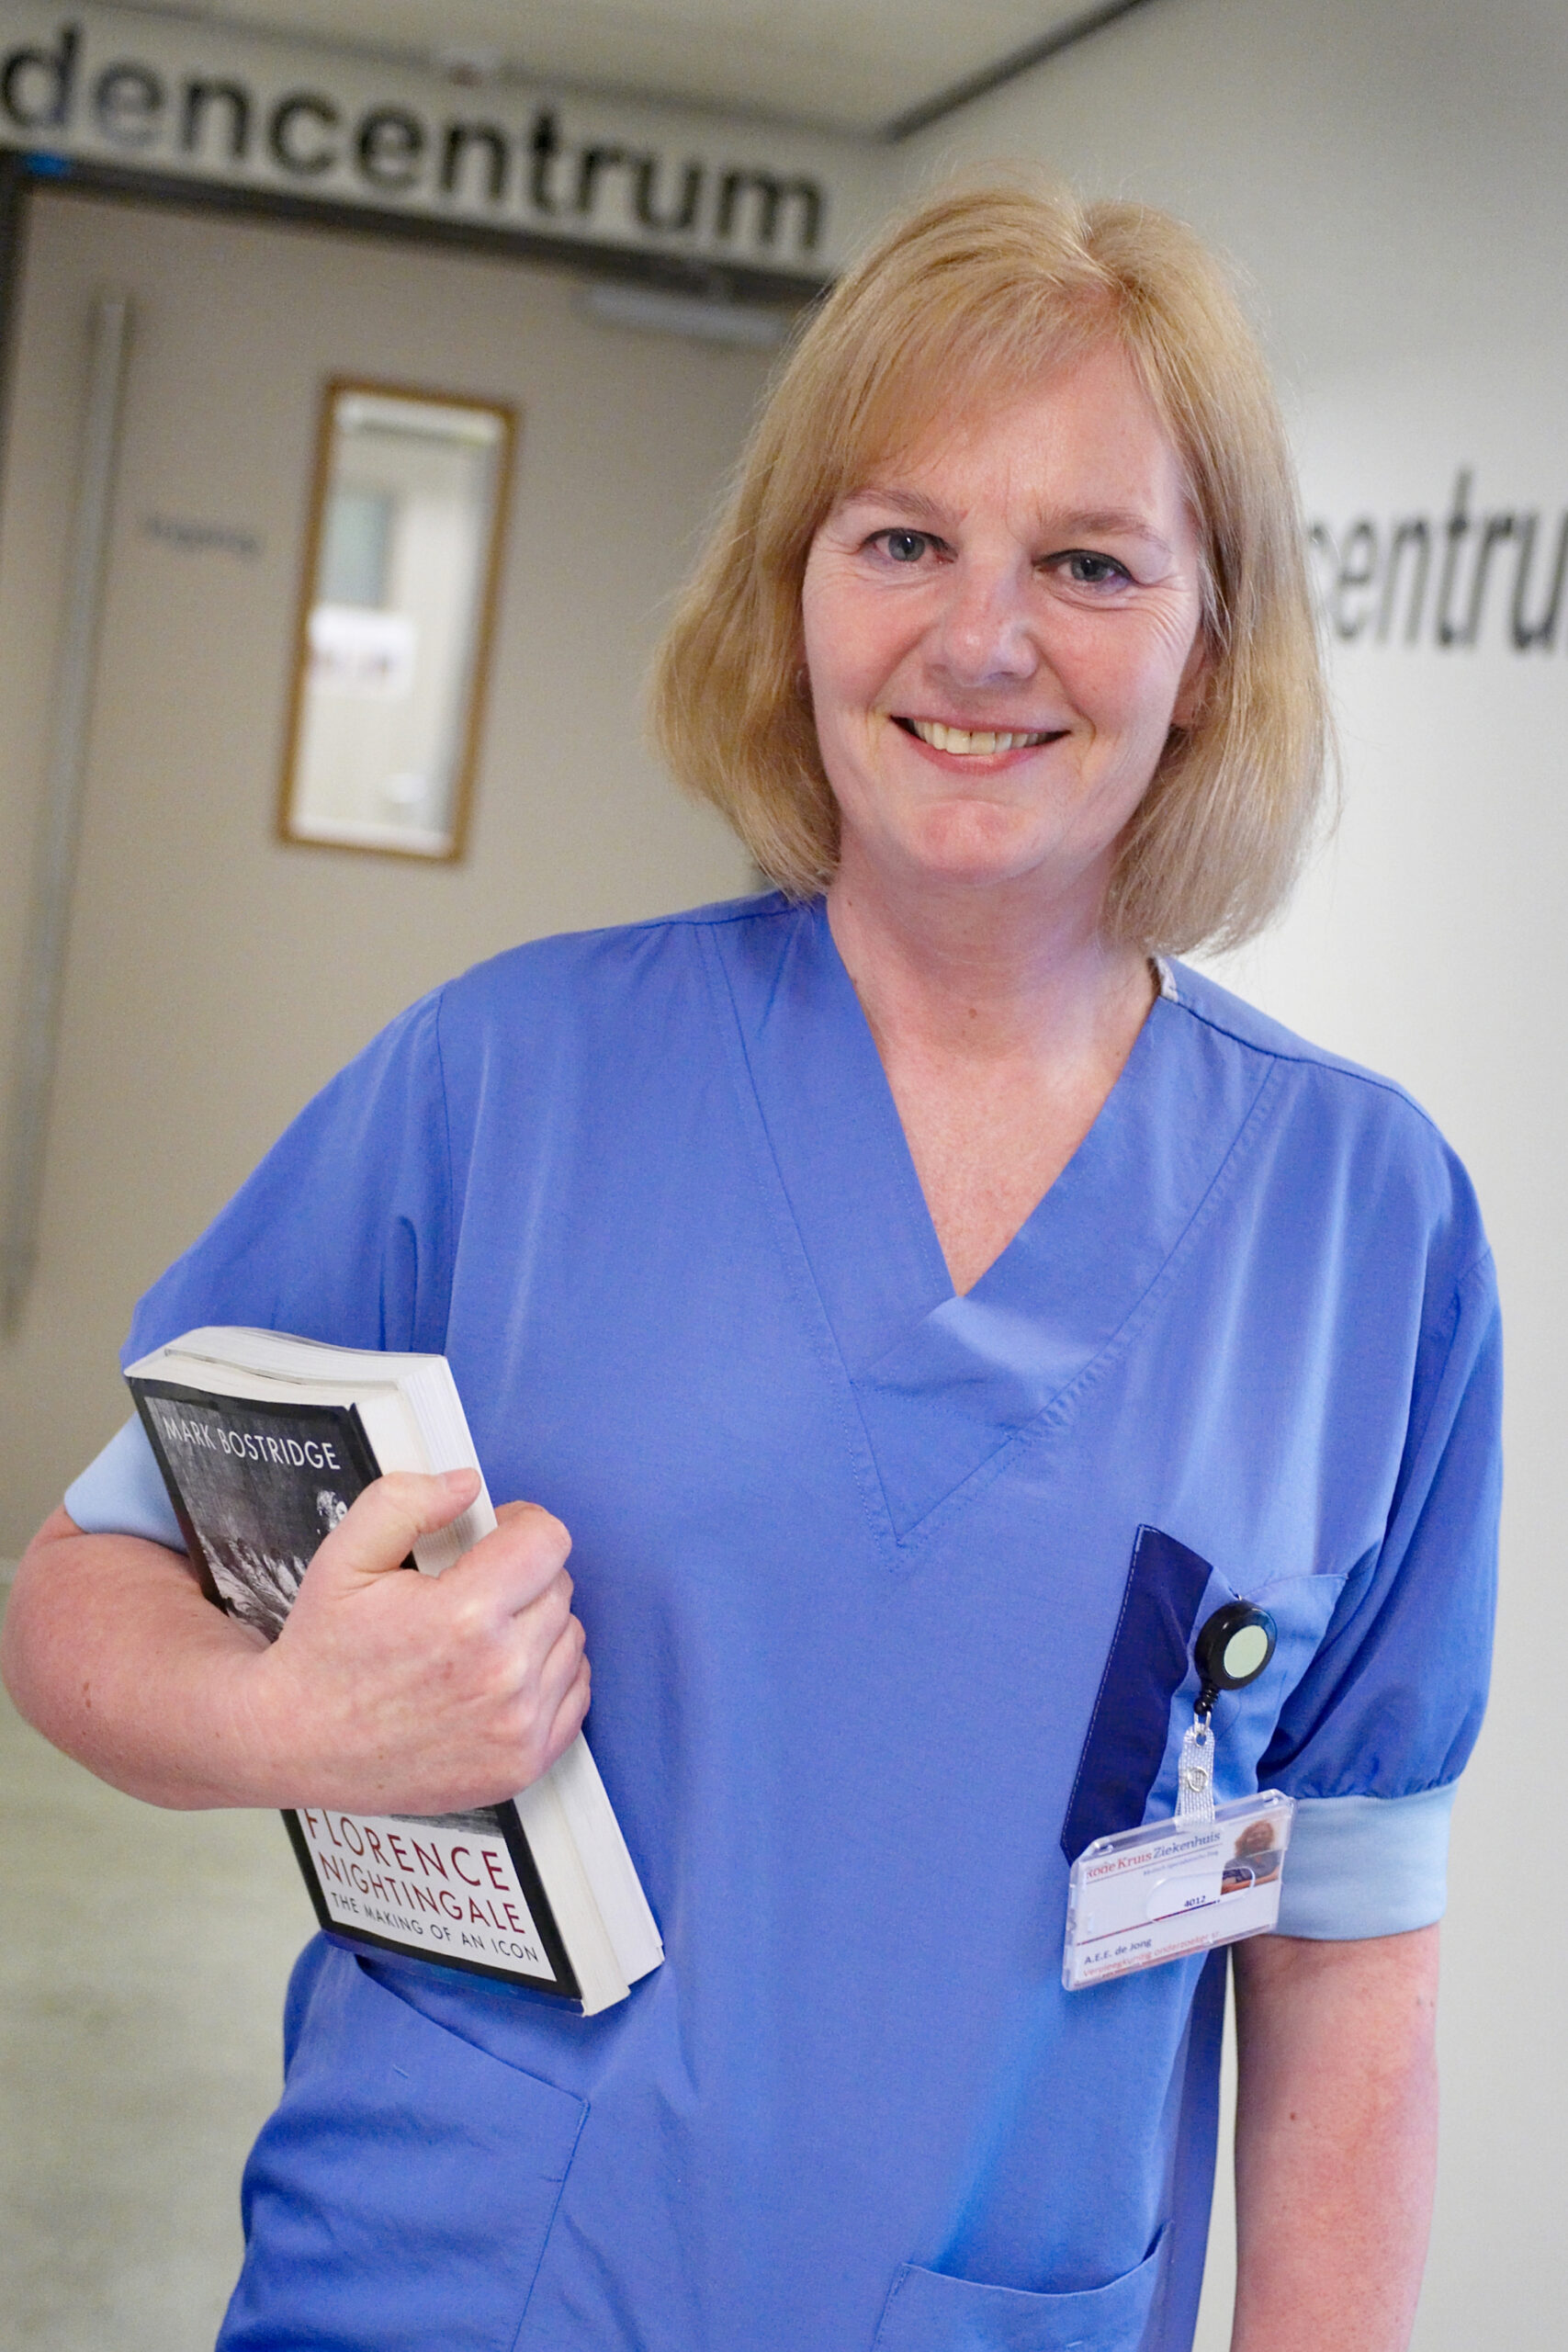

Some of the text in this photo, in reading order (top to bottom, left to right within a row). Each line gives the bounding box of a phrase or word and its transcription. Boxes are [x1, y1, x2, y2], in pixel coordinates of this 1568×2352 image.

[2, 22, 827, 254] dencentrum
[163, 1417, 341, 1470] MARK BOSTRIDGE
[304, 1808, 510, 1892] FLORENCE
[1117, 1852, 1152, 1870] Kruis
[1153, 1831, 1221, 1860] Ziekenhuis
[318, 1850, 526, 1934] NIGHTINGALE
[1183, 1894, 1207, 1907] 4012
[332, 1893, 539, 1962] THE MAKING OF AN ICON
[1114, 1945, 1127, 1955] de
[1130, 1939, 1152, 1952] Jong
